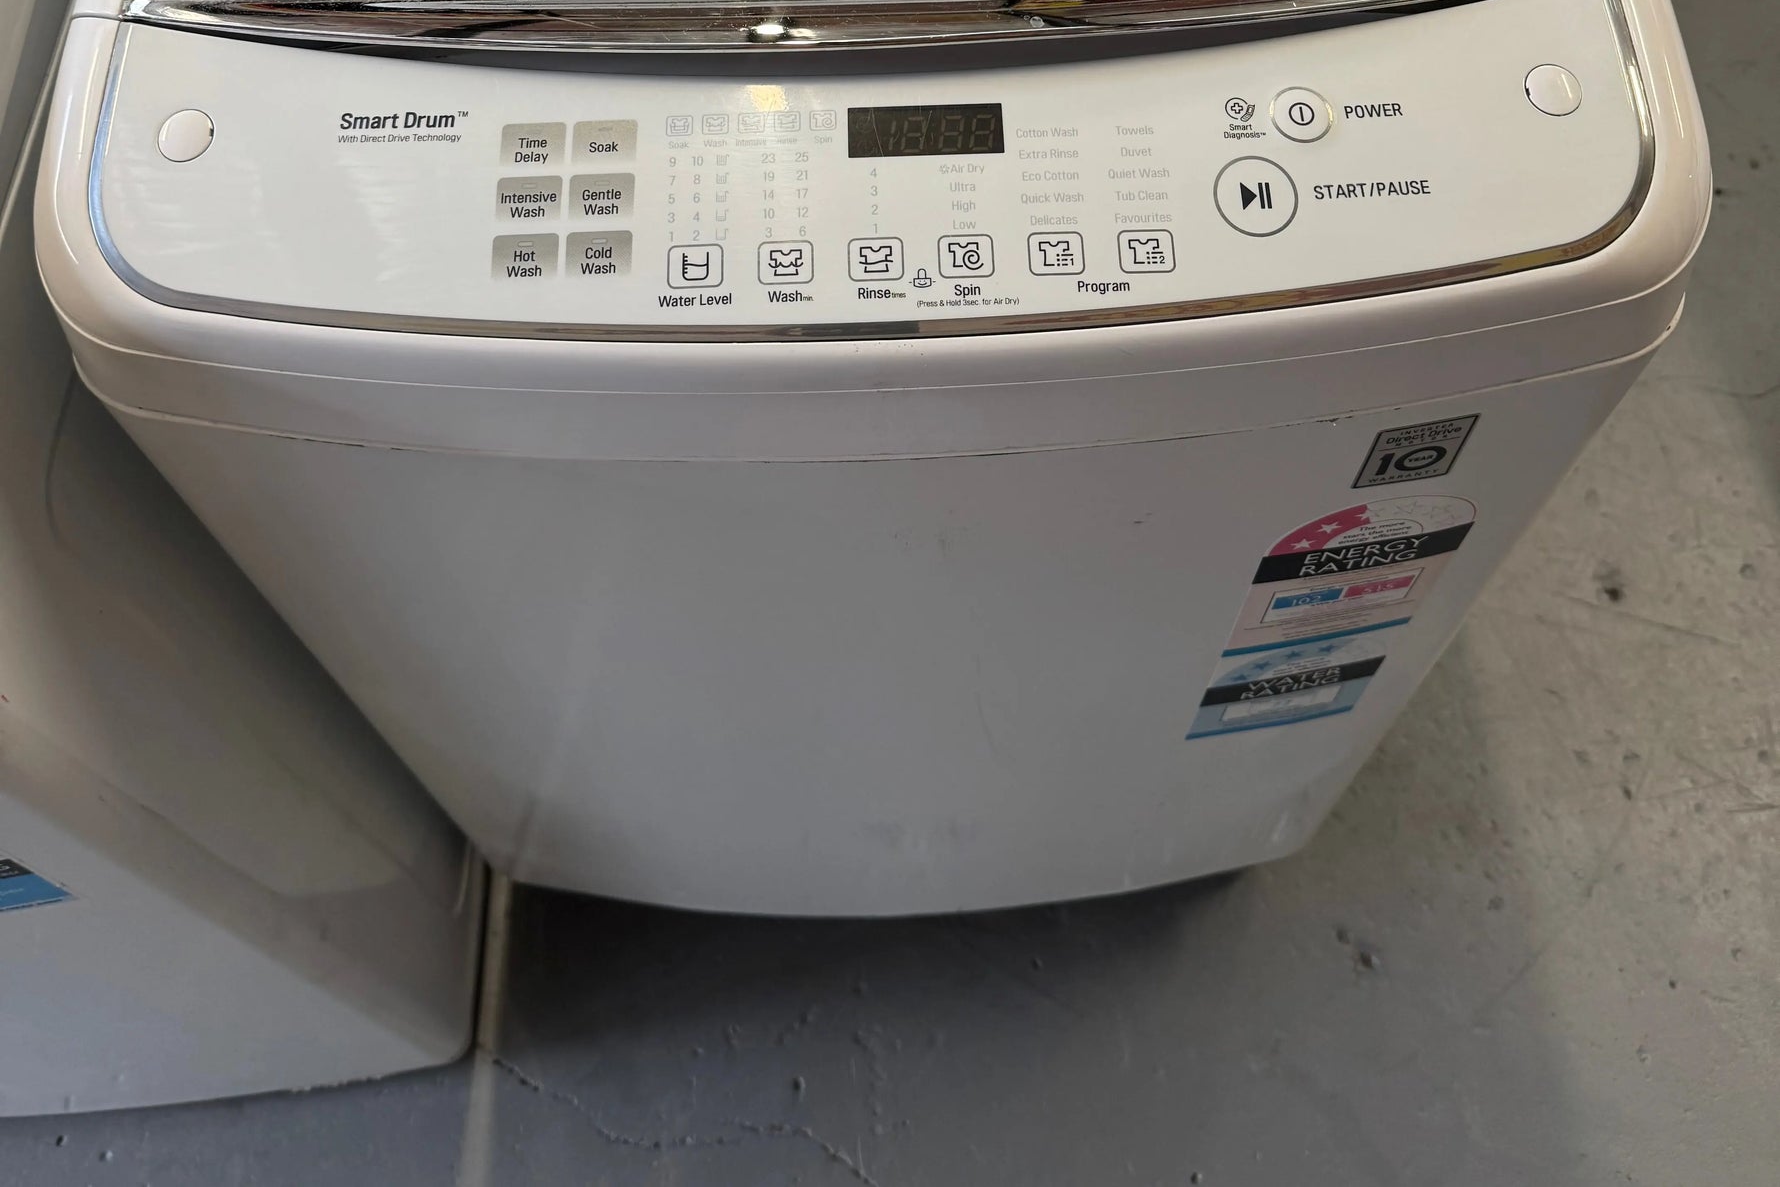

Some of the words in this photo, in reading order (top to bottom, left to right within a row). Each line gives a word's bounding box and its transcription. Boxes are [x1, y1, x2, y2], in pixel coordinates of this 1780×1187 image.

[1344, 102, 1403, 119] POWER
[340, 112, 399, 130] Smart
[1016, 128, 1048, 138] Cotton
[1050, 128, 1078, 138] Wash
[1115, 126, 1154, 136] Towels
[1230, 123, 1252, 132] Smart
[338, 134, 358, 144] With
[360, 134, 386, 144] Direct
[388, 134, 411, 143] Drive
[412, 132, 462, 144] Technology
[518, 137, 548, 149] Time
[704, 139, 728, 148] Wash
[814, 136, 832, 144] Spin
[588, 142, 618, 153] Soak
[668, 141, 689, 149] Soak
[795, 152, 808, 162] 25
[1018, 150, 1048, 160] Extra
[1050, 148, 1079, 158] Rinse
[1120, 147, 1152, 157] Duvet
[514, 152, 549, 164] Delay
[669, 157, 676, 167] 9
[692, 156, 704, 166] 10
[761, 153, 776, 164] 23
[870, 168, 878, 178] 4
[950, 164, 964, 174] Air
[967, 164, 985, 174] Dry
[1108, 168, 1136, 180] Quiet
[1139, 168, 1170, 178] Wash
[693, 174, 700, 185] 8
[763, 172, 775, 182] 19
[796, 170, 808, 180] 21
[1022, 172, 1042, 182] Eco
[1044, 170, 1080, 180] Cotton
[669, 176, 676, 186] 7
[870, 186, 878, 196] 3
[950, 182, 976, 192] Ultra
[1313, 180, 1431, 200] START/PAUSE
[500, 191, 557, 204] Intensive
[582, 188, 622, 202] Gentle
[668, 194, 676, 204] 5
[693, 193, 700, 204] 6
[762, 190, 774, 200] 14
[796, 189, 808, 199] 17
[1020, 194, 1050, 205] Quick
[1054, 192, 1084, 202] Wash
[1115, 191, 1136, 201] Tub
[1138, 190, 1168, 200] Clean
[584, 203, 619, 216] Wash
[871, 204, 878, 215] 2
[952, 200, 976, 212] High
[510, 206, 546, 218] Wash
[668, 212, 675, 223] 3
[692, 212, 700, 222] 4
[763, 208, 775, 219] 10
[797, 208, 808, 218] 12
[1030, 214, 1078, 226] Delicates
[1114, 213, 1172, 224] Favourites
[952, 220, 976, 230] Low
[692, 230, 700, 241] 2
[765, 227, 772, 238] 3
[799, 226, 806, 236] 6
[513, 250, 536, 262] Hot
[584, 247, 612, 259] Cold
[506, 265, 542, 278] Wash
[580, 262, 616, 274] Wash
[954, 284, 981, 298] Spin
[1078, 280, 1130, 294] Program
[858, 288, 890, 299] Rinse
[658, 295, 696, 307] Water
[700, 292, 732, 306] Level
[916, 300, 938, 308] (Press
[982, 298, 992, 306] for
[1004, 298, 1020, 306] Dry)
[1400, 422, 1454, 436] INVERTER
[1386, 432, 1426, 444] Direct
[1428, 427, 1462, 438] Drive
[1375, 446, 1448, 476] 10
[1408, 454, 1434, 463] YEAR
[1368, 469, 1441, 484] WARRANTY
[1304, 535, 1429, 564] ENERGY
[1299, 548, 1417, 576] RATING
[1248, 667, 1341, 690] WATER
[1240, 675, 1340, 700] RATING
